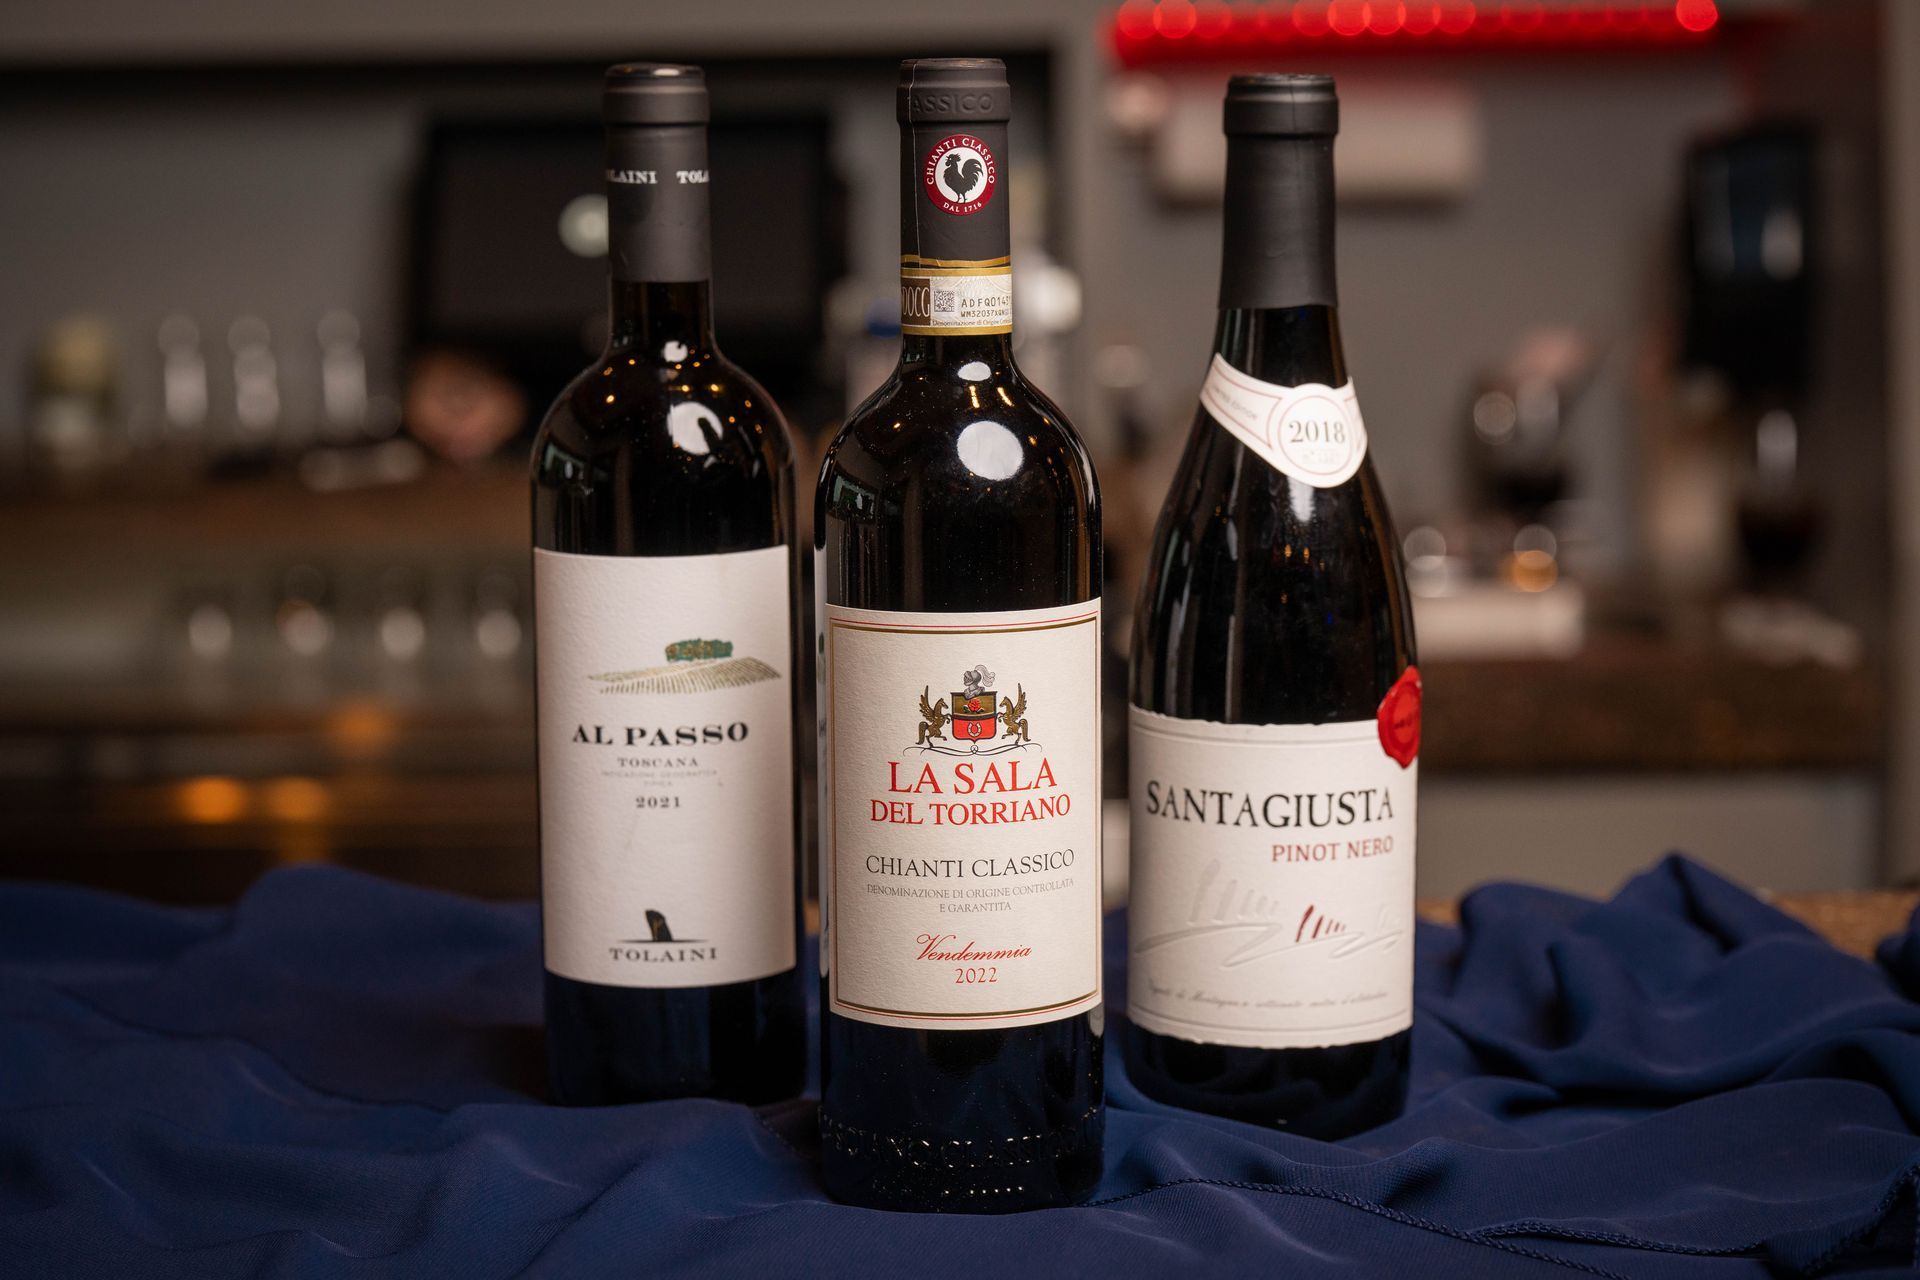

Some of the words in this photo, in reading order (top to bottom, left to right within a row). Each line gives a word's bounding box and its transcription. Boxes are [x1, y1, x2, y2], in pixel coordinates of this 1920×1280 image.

[926, 138, 956, 185] CHIANTI
[962, 137, 995, 184] CLASSICO
[943, 202, 960, 213] DAL
[964, 202, 982, 213] 1716
[1289, 420, 1345, 444] 2018
[572, 724, 613, 745] AL
[625, 721, 749, 747] PASSO
[617, 757, 699, 768] TOSCANA
[888, 761, 943, 794] LA
[953, 757, 1057, 795] SALA
[635, 796, 681, 809] 2021
[870, 799, 924, 825] DEL
[929, 794, 1071, 826] TORRIANO
[1146, 780, 1395, 828] SANTAGIUSTA
[1271, 842, 1341, 863] PINOT
[1346, 835, 1394, 859] NERO
[866, 855, 964, 878] CHIANTI
[971, 848, 1075, 878] CLASSICO
[867, 883, 950, 899] DENOMINAZIONE
[952, 888, 964, 899] DI
[966, 887, 1011, 899] ORIGINE
[1012, 878, 1075, 897] CONTROLLATA
[939, 903, 946, 913] E
[947, 901, 1012, 913] GARANTITA
[608, 947, 718, 962] TOLAINI
[916, 933, 1033, 961] Vendemmia
[954, 967, 998, 984] 2022
